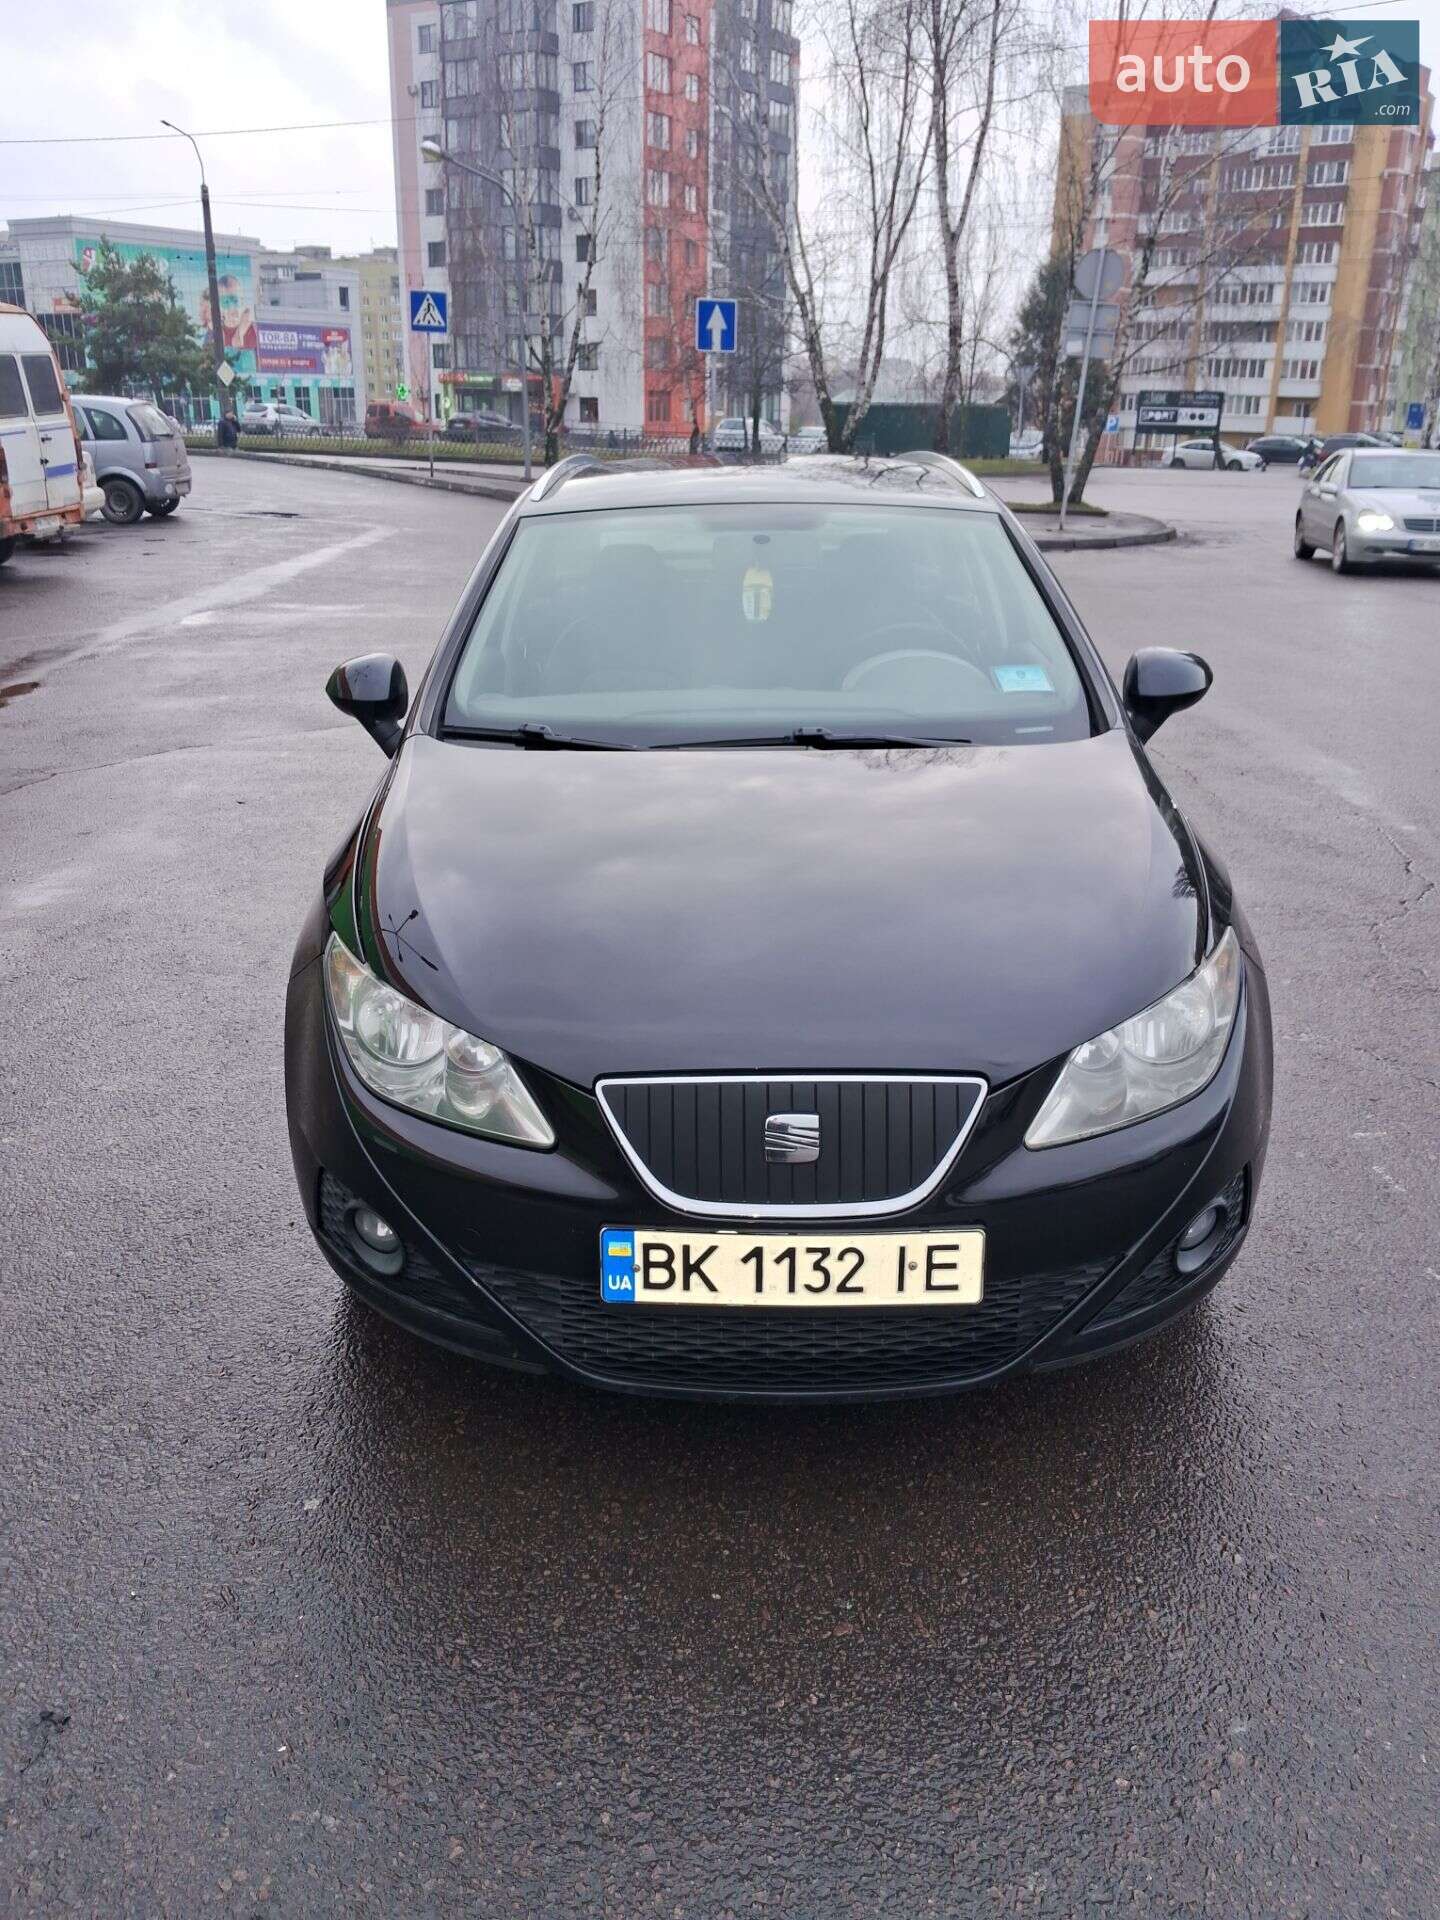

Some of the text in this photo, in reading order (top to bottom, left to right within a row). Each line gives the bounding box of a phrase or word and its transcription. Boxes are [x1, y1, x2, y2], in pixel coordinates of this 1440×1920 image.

[608, 1274, 632, 1291] UA
[641, 1242, 960, 1294] BK 1132 IE
